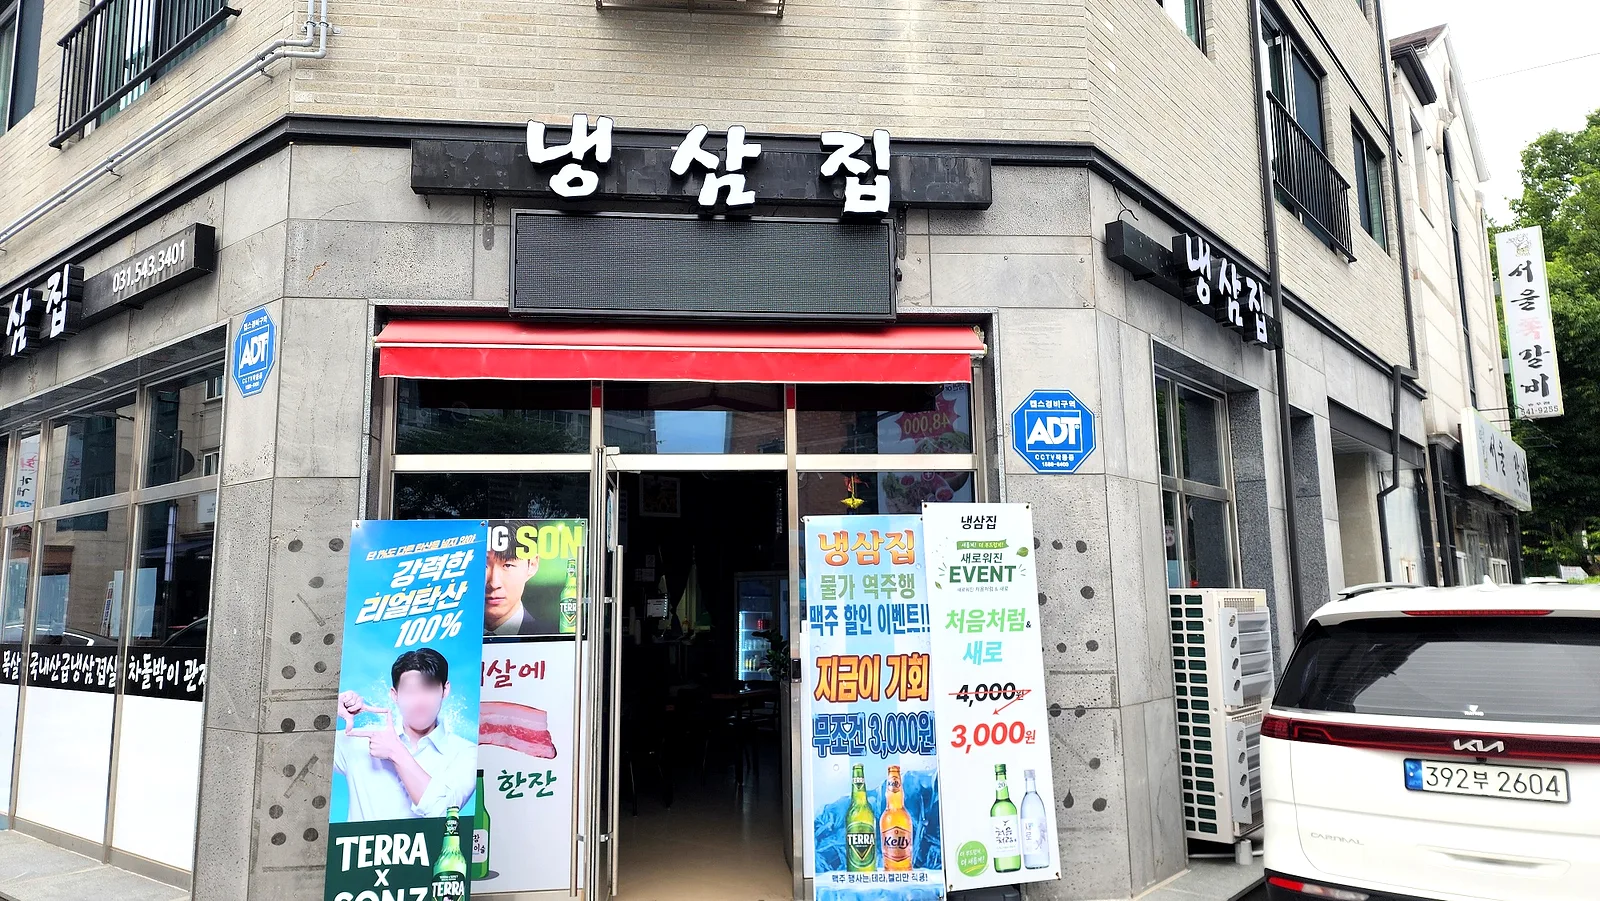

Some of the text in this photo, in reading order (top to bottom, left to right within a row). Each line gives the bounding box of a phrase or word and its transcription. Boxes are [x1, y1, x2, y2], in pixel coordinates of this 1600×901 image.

[111, 239, 186, 294] 031.543.3401
[1185, 233, 1268, 343] 냉삼집
[239, 331, 270, 370] ADT
[1027, 416, 1080, 445] ADT
[961, 515, 997, 530] 냉삼집
[515, 525, 583, 560] SON
[817, 529, 915, 567] 냉삼집
[960, 553, 1003, 563] 새로워진
[390, 549, 474, 588] 강력한
[949, 565, 1017, 583] EVENT
[355, 580, 469, 625] 리얼탄산
[820, 573, 915, 600] 물가 역주행
[560, 602, 577, 613] TERR
[809, 603, 931, 637] 맥주 할인 이벤트!!
[394, 610, 464, 648] 100%
[962, 640, 1003, 665] 새로
[128, 653, 179, 690] 차돌박이
[481, 658, 546, 688] 살에
[813, 652, 930, 702] 지금이 기회
[812, 711, 937, 760] 무조건 3,000원
[950, 721, 1036, 754] 3,000원
[497, 769, 557, 799] 한잔
[1426, 765, 1561, 796] 392부 2604
[335, 832, 430, 872] TERRA
[847, 834, 875, 845] TERRA
[883, 836, 911, 849] Kelly
[432, 880, 465, 898] TERRA
